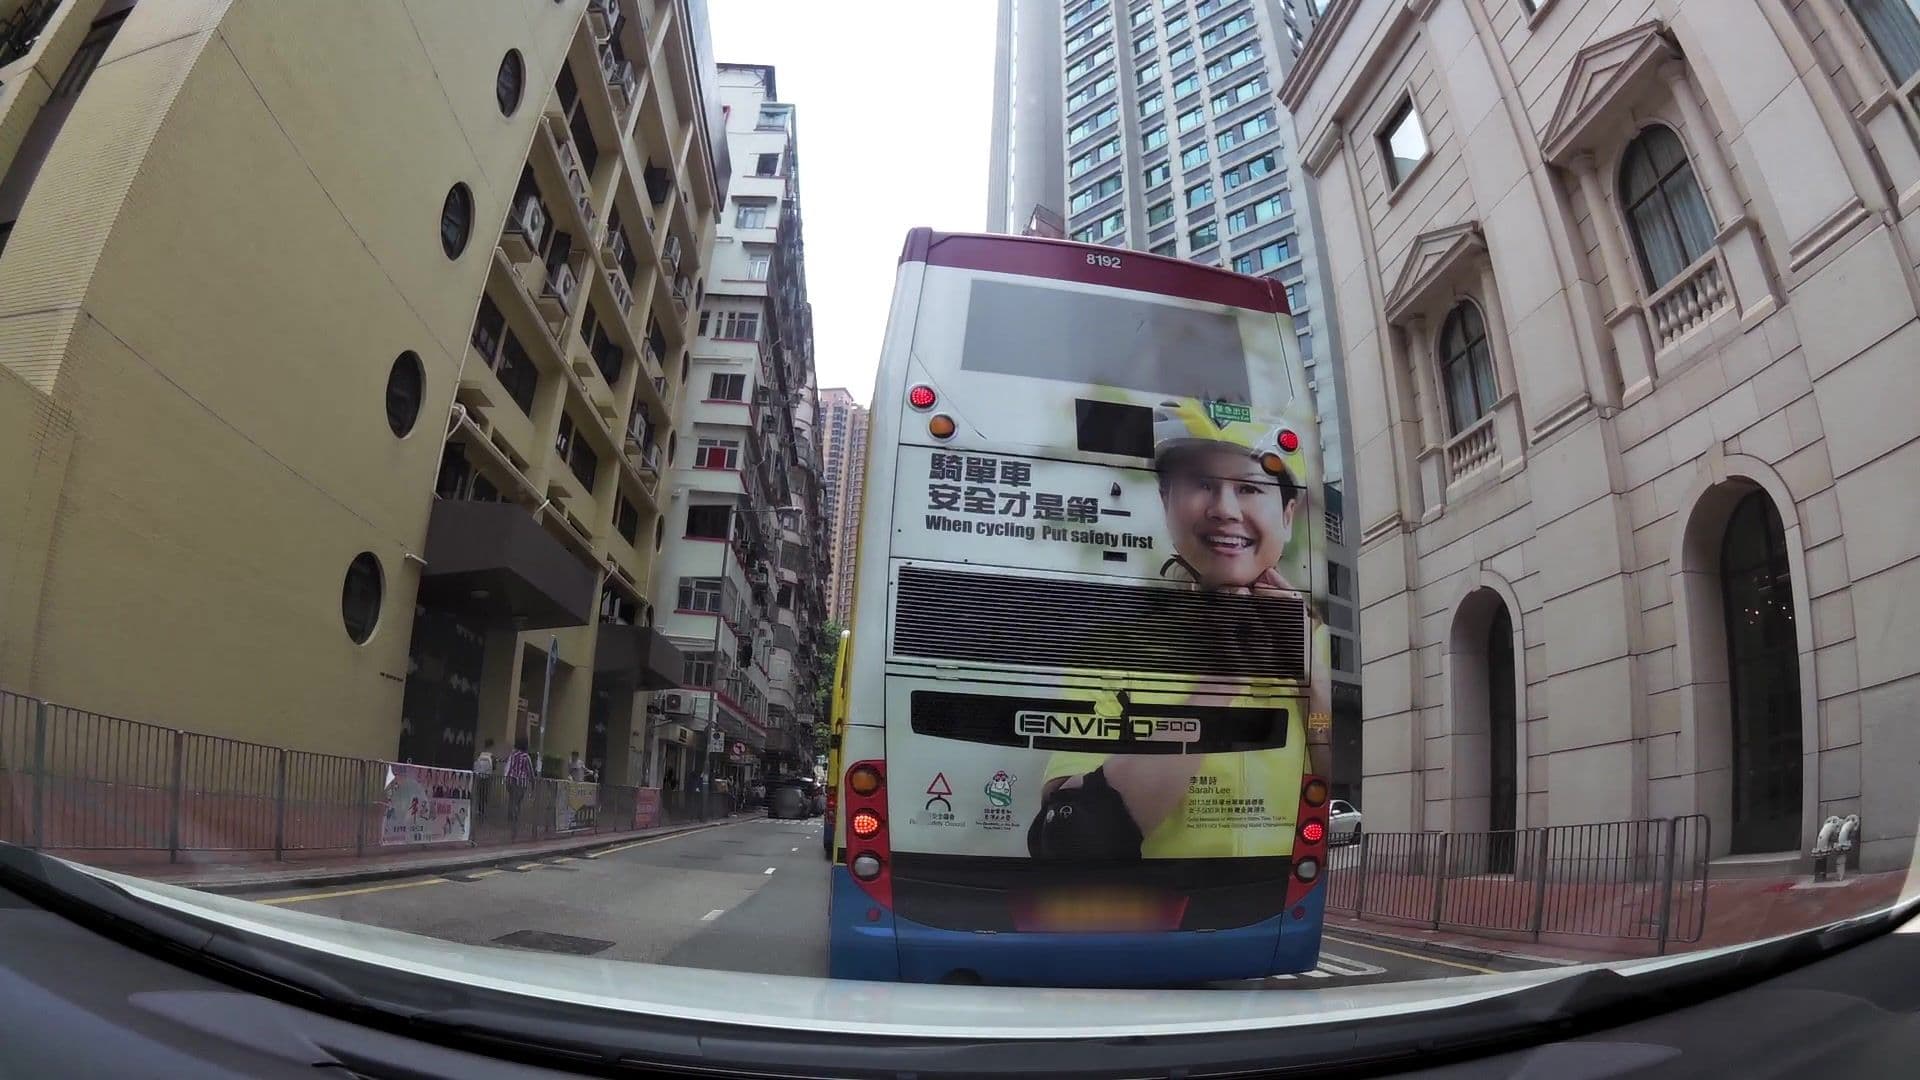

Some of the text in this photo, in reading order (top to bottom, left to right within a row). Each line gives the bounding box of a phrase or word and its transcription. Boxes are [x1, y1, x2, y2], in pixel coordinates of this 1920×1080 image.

[1086, 253, 1122, 269] 8192
[929, 453, 1032, 487] 騎單車
[928, 484, 1131, 524] 安全才是第一
[925, 514, 1154, 550] When cycling Put safety first
[1189, 786, 1214, 794] Sarah
